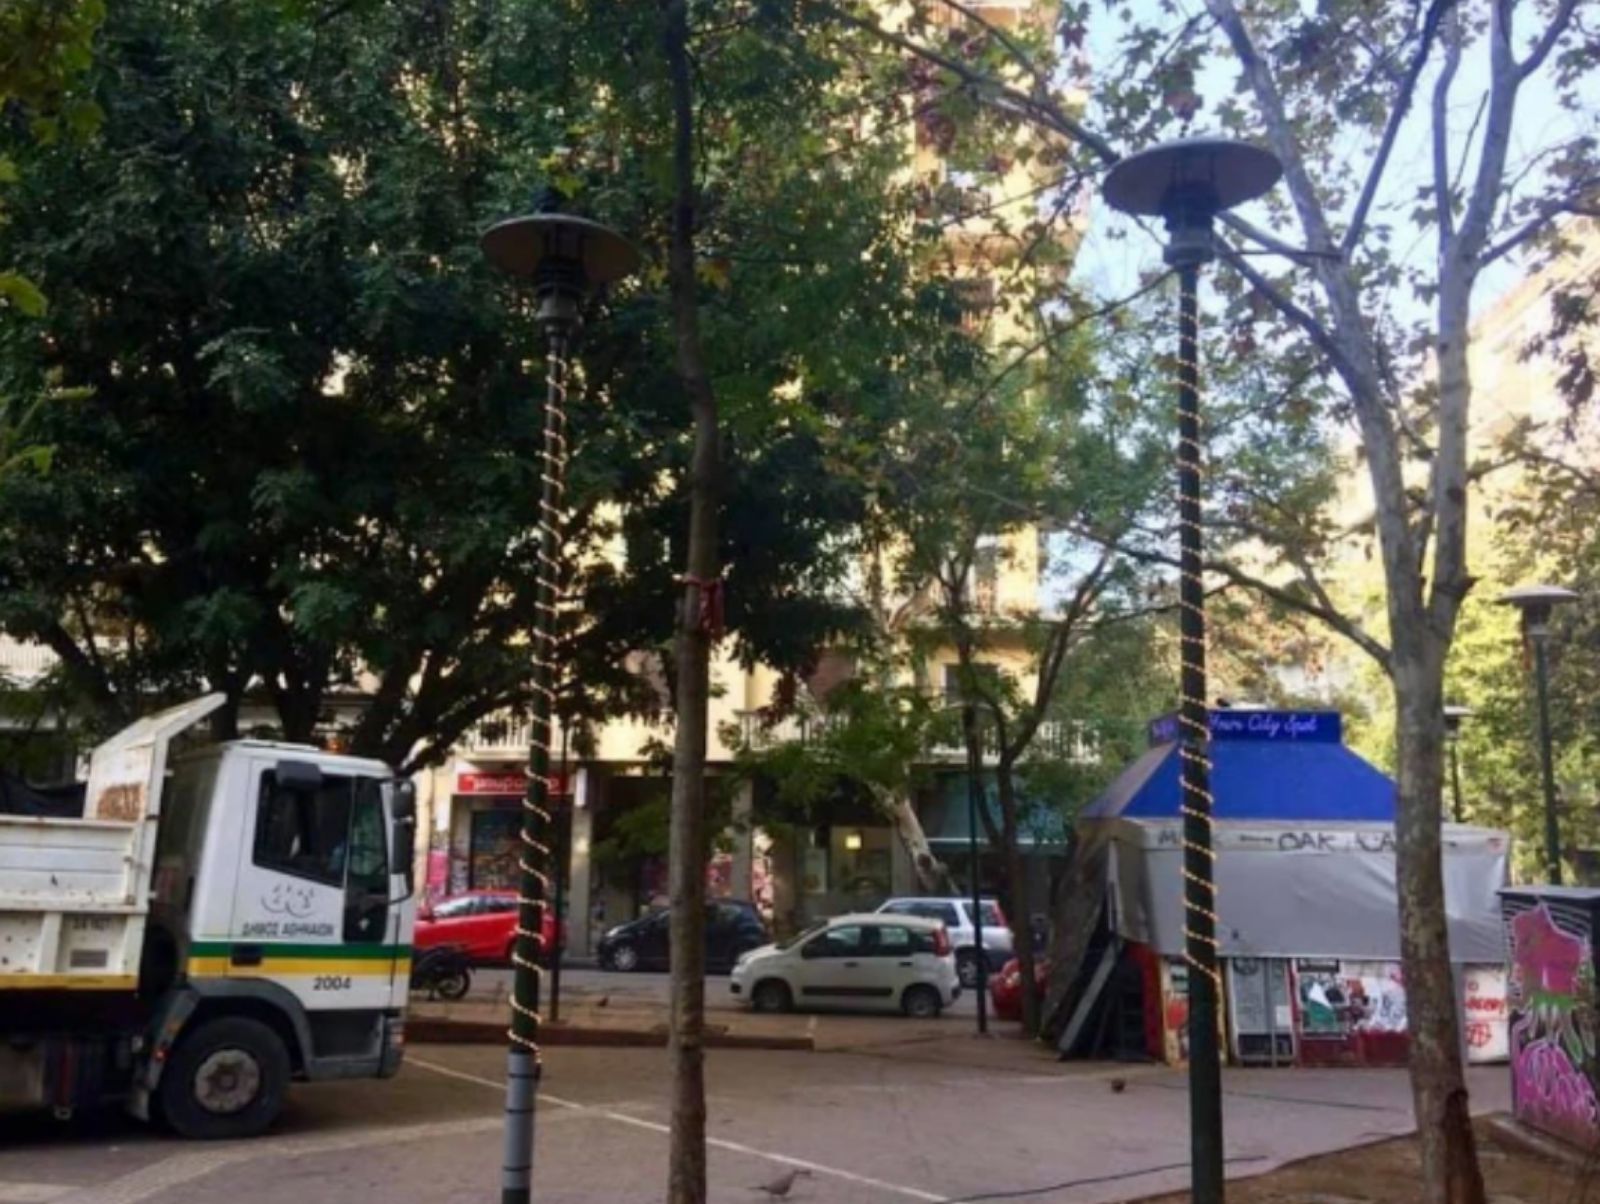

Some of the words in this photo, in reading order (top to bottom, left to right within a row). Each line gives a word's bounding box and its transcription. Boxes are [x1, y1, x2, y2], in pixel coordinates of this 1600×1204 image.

[1248, 713, 1281, 737] City
[1284, 714, 1318, 738] Spot
[313, 976, 351, 991] 2004
